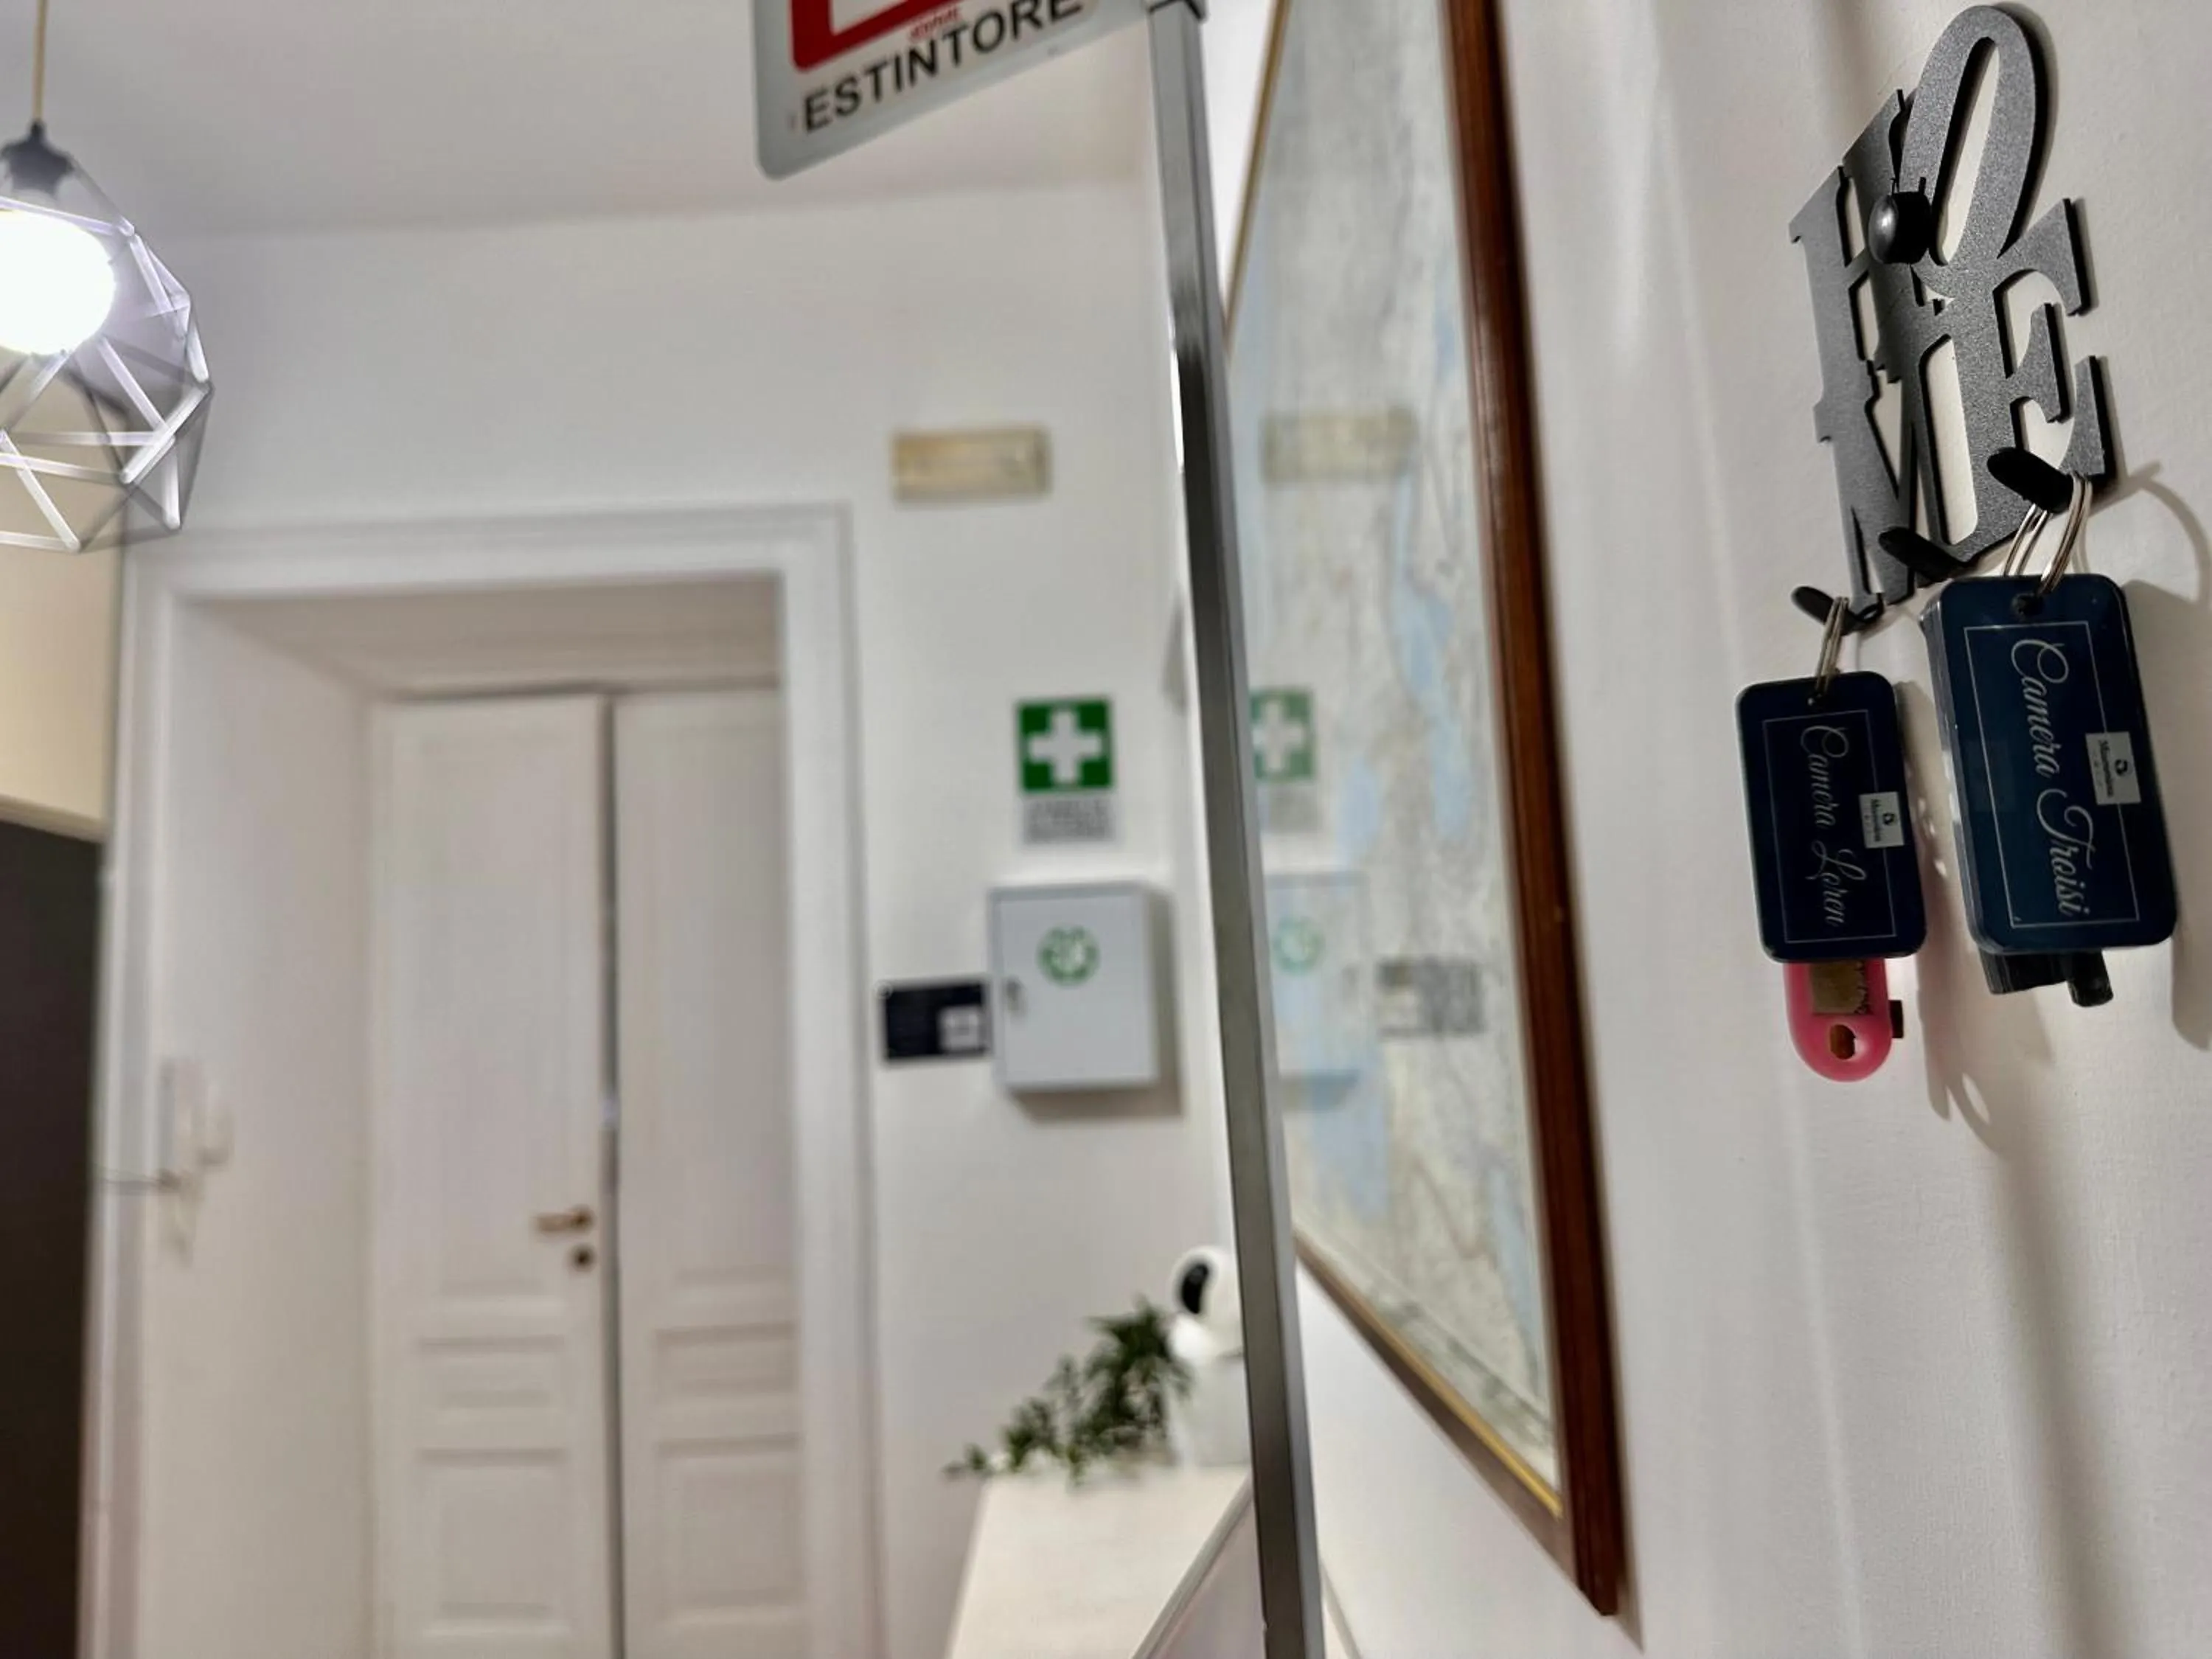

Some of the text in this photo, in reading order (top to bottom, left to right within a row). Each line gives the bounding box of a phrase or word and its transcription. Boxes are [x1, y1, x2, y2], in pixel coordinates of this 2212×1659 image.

[1800, 724, 1867, 928] Camera Loren
[2011, 638, 2096, 918] Camera Troisi
